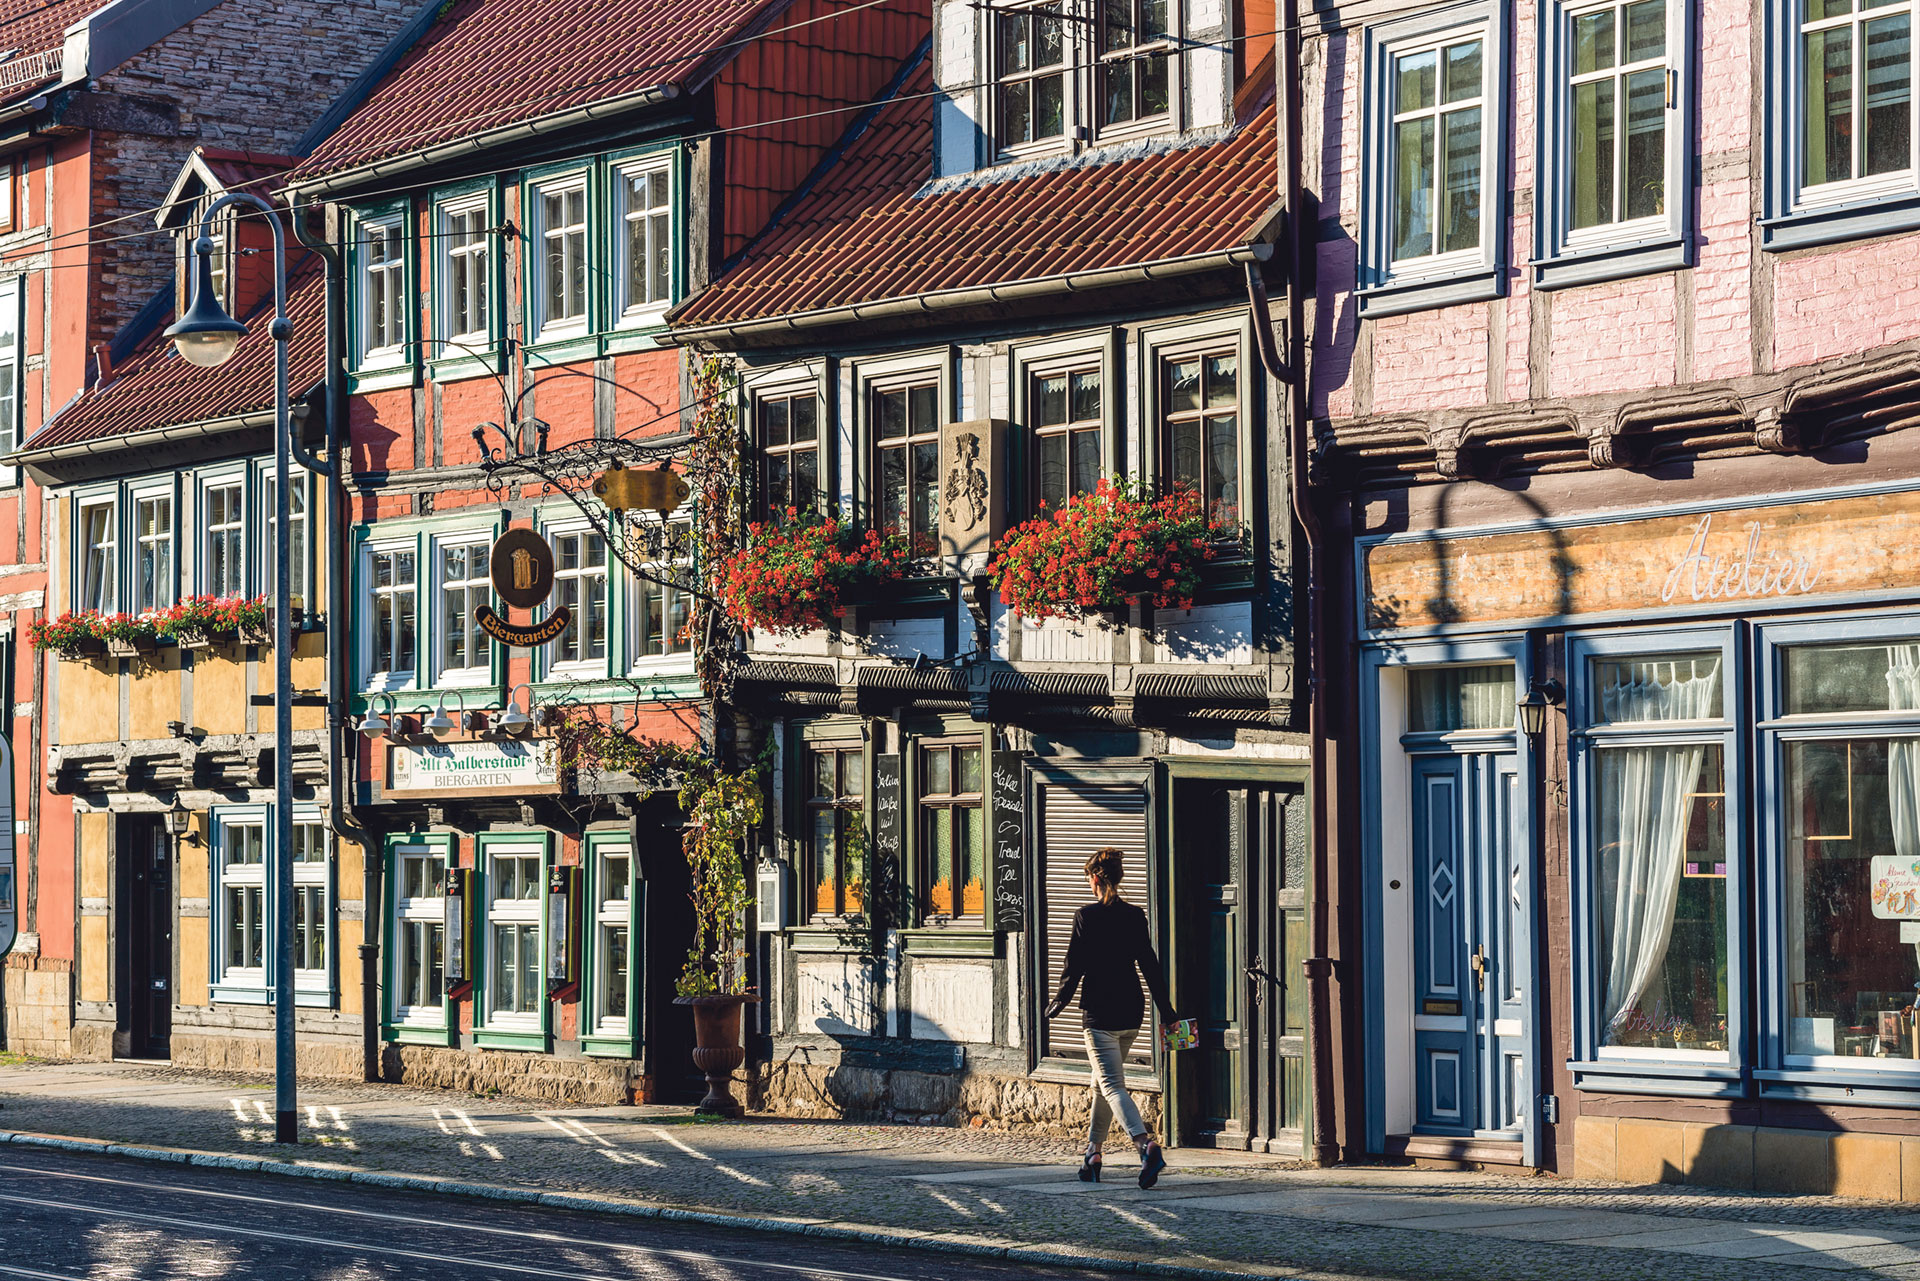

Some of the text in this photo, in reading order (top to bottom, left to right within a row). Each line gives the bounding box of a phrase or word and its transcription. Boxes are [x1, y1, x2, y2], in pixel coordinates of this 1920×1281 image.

[1661, 513, 1821, 603] Atelier
[482, 613, 565, 645] Biergarten
[454, 740, 522, 753] RESTAURANT
[434, 772, 513, 787] BIERGARTEN
[1611, 992, 1687, 1032] Atelier
